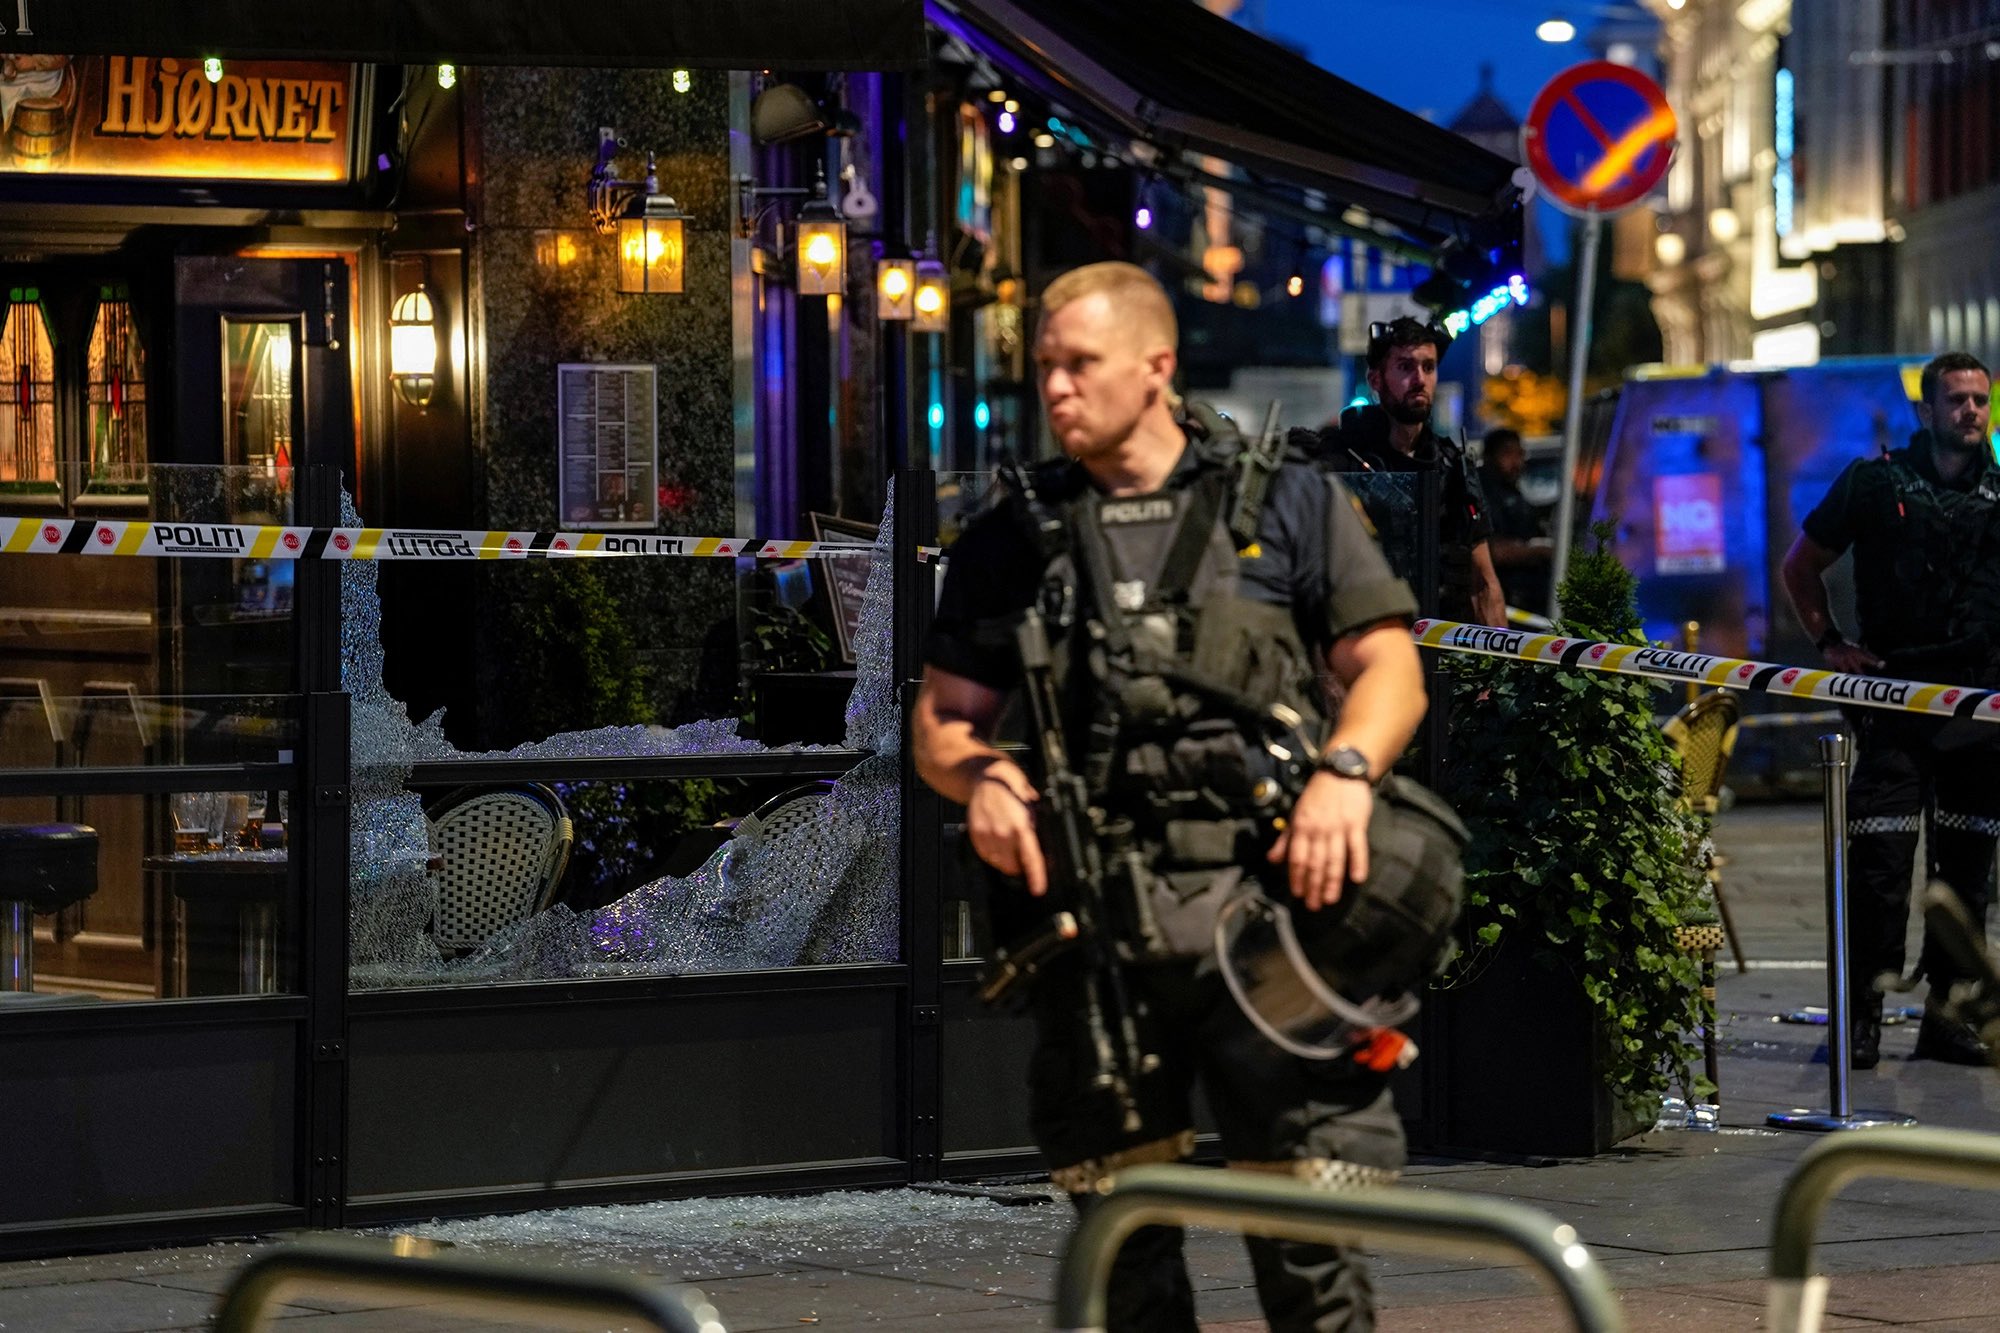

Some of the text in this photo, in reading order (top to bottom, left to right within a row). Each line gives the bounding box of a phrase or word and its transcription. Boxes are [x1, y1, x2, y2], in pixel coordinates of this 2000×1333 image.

[153, 525, 246, 548] POLITI
[387, 537, 476, 557] POLITI
[1453, 626, 1525, 655] POLITI
[1633, 648, 1714, 672] POLITI
[1828, 675, 1911, 705] POLITI
